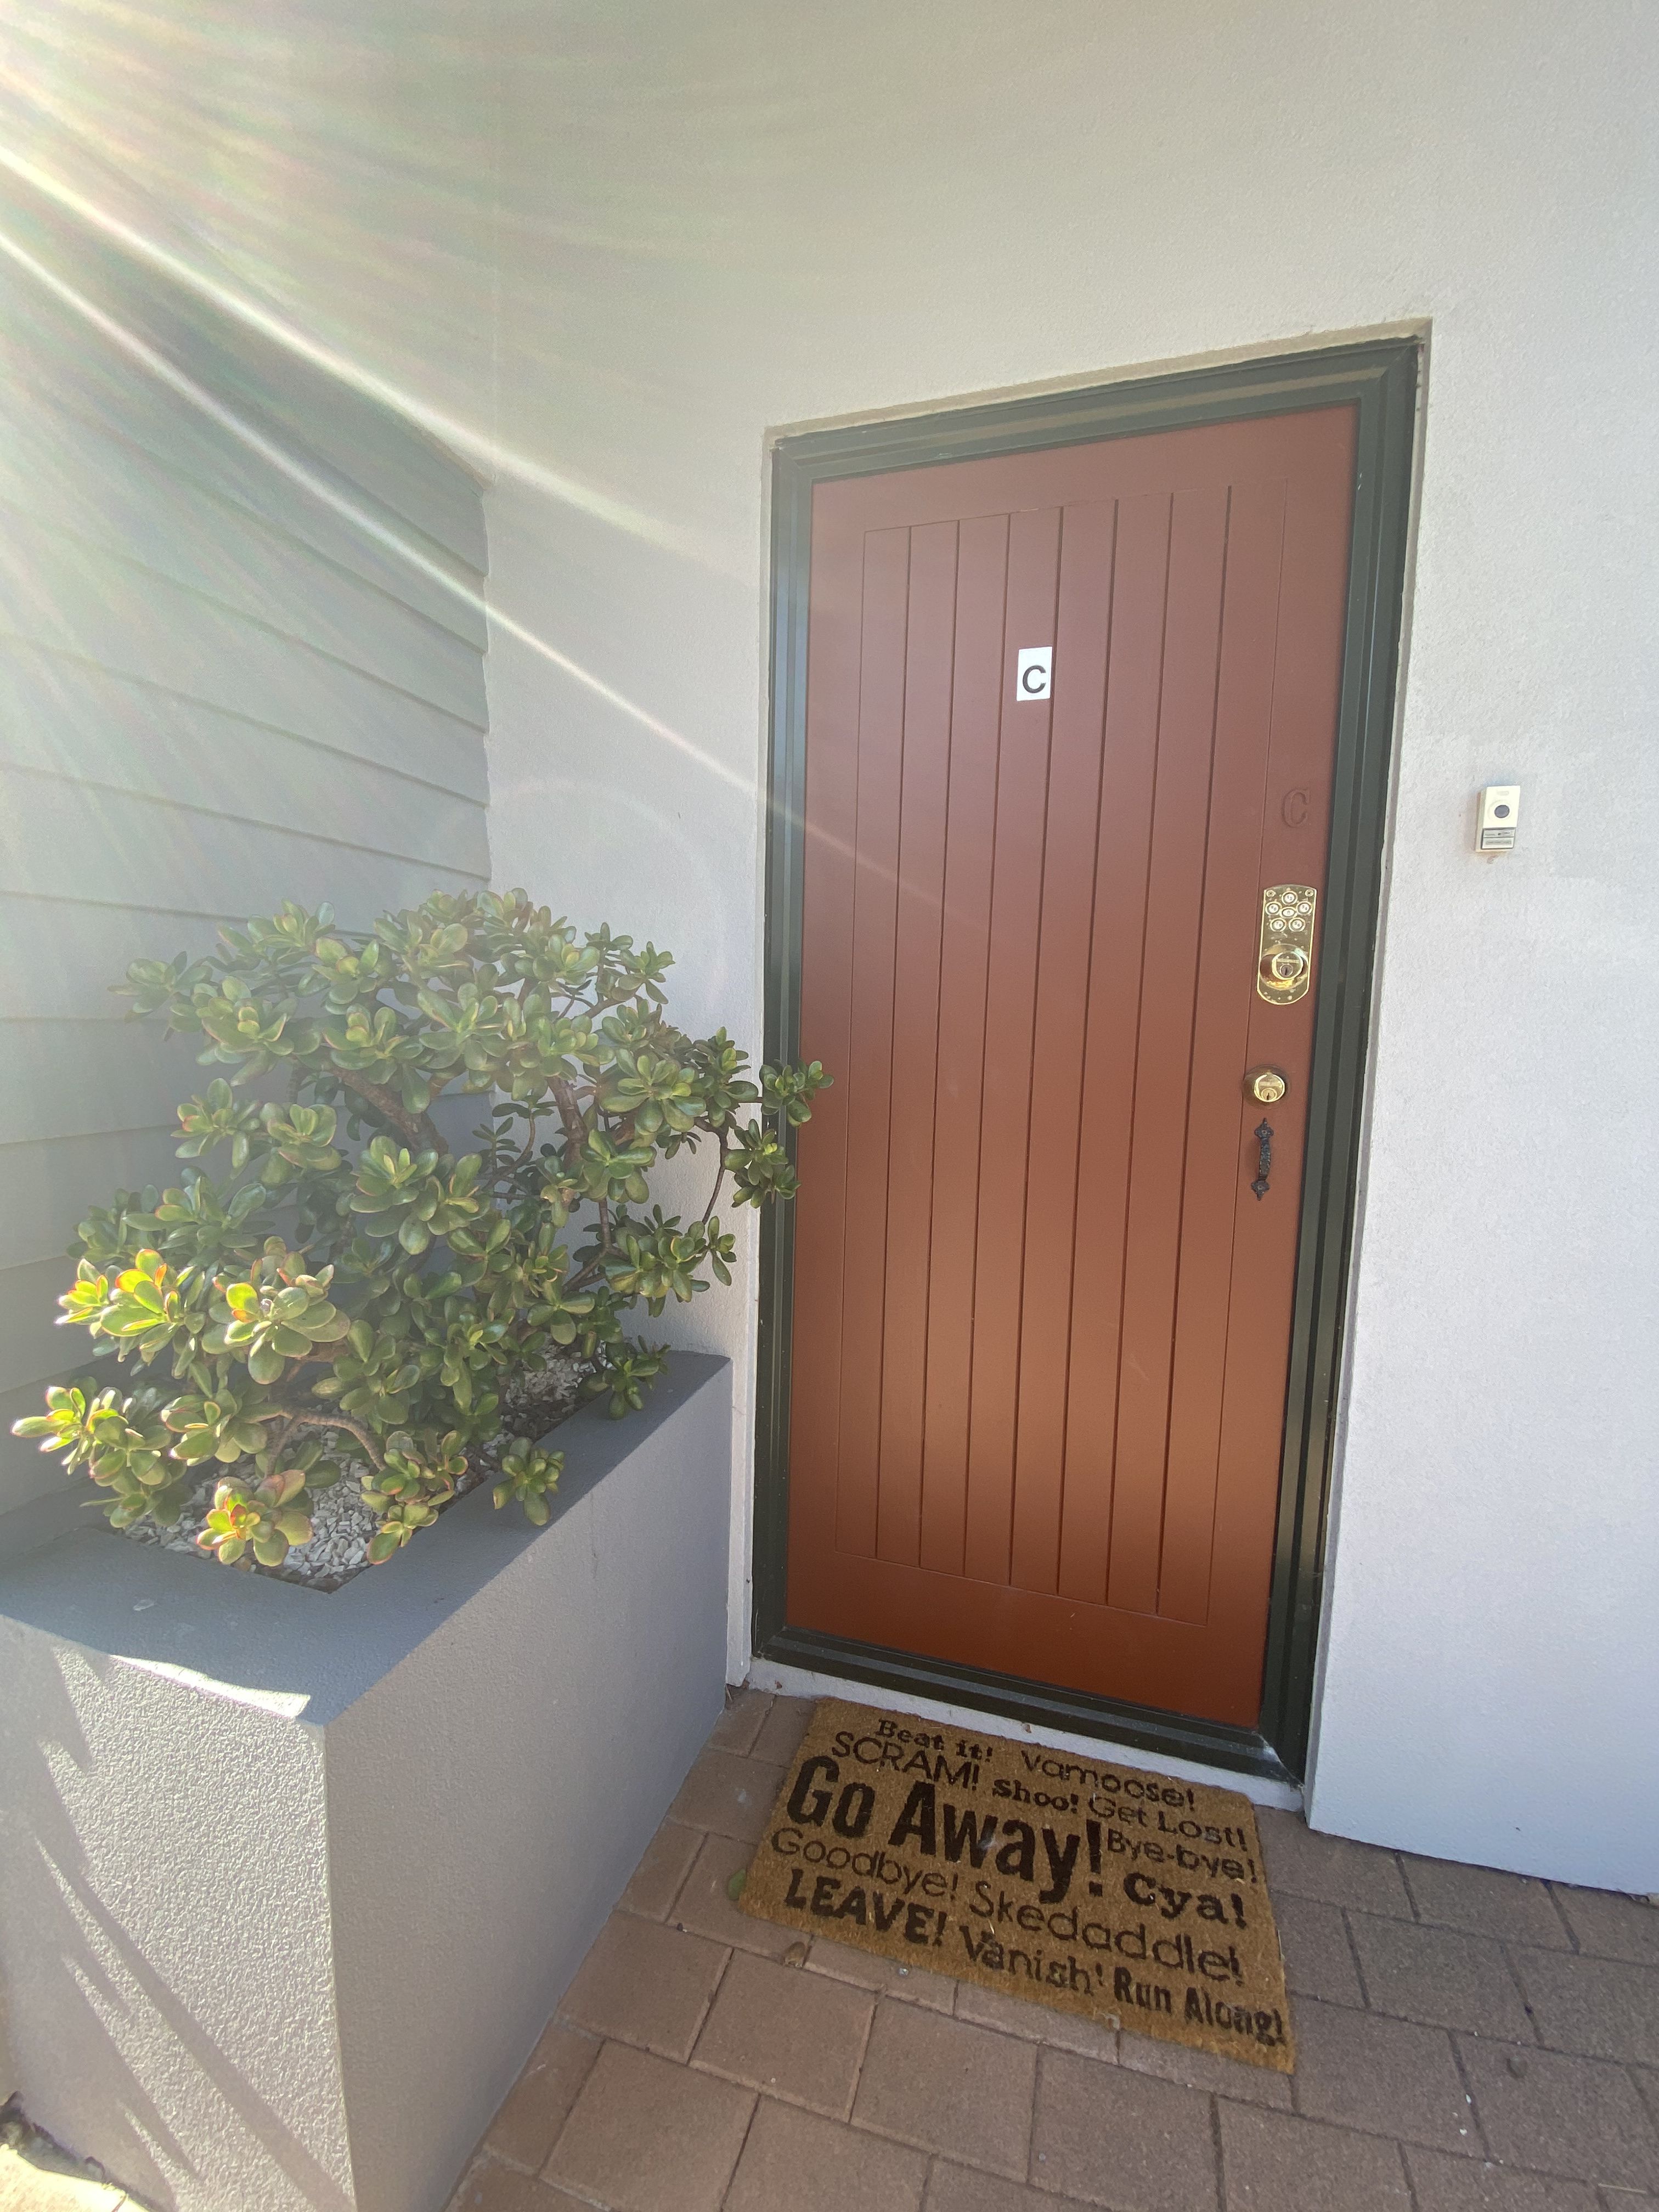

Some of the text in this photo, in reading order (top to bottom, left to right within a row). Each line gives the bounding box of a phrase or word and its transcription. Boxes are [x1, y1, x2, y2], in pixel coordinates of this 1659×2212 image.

[1023, 665, 1046, 693] C
[1281, 787, 1311, 828] C
[832, 1731, 980, 1791] SCRAM!
[1088, 1796, 1147, 1827] Get
[1158, 1811, 1248, 1852] Lost!
[877, 1718, 944, 1751] Beat
[1021, 1750, 1194, 1812] Vamoose!
[787, 1756, 1103, 1904] Go Away!
[1107, 1828, 1257, 1884] Bye-bye!
[771, 1827, 1246, 1988] Goodbye! Skedaddle!
[785, 1868, 1286, 2047] LEAVE! Vanish! Run Along!
